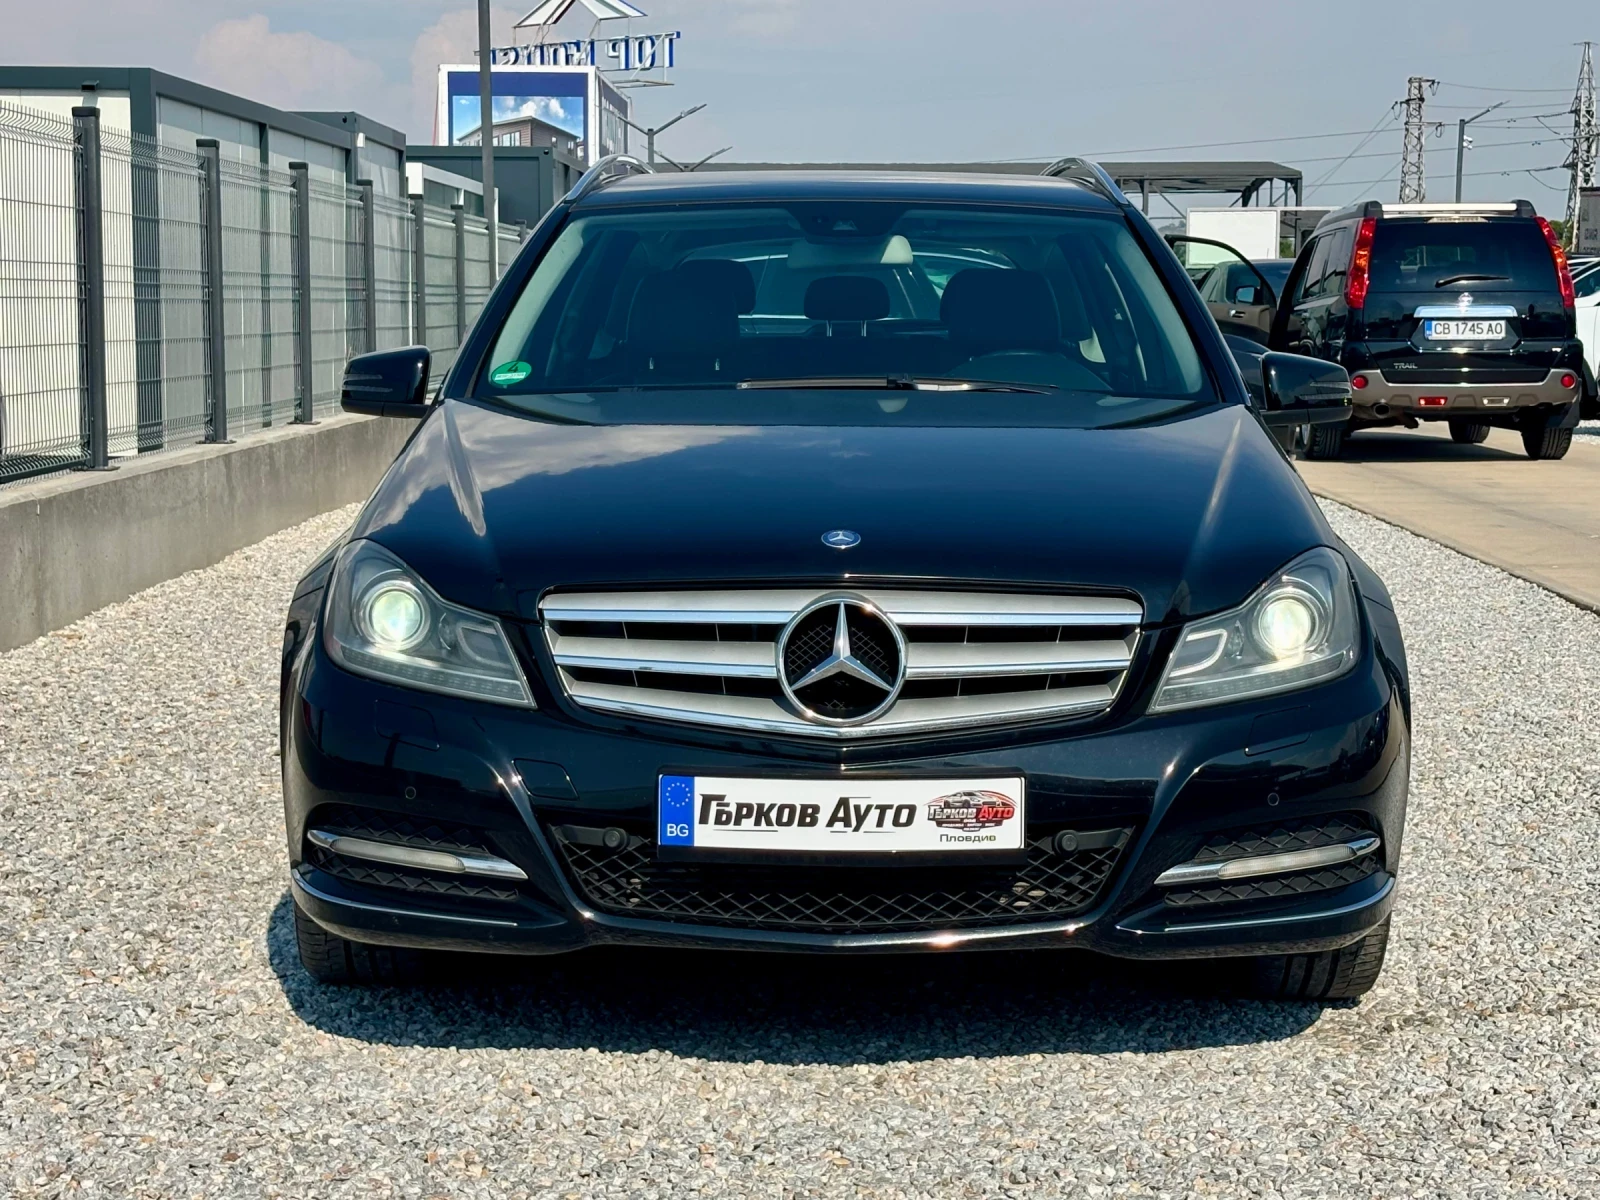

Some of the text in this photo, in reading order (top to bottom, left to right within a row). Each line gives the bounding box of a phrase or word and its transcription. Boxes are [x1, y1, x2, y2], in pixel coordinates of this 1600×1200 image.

[1434, 322, 1503, 335] CB 1745 AO
[666, 823, 689, 837] BG
[939, 833, 997, 843] Пловдив
